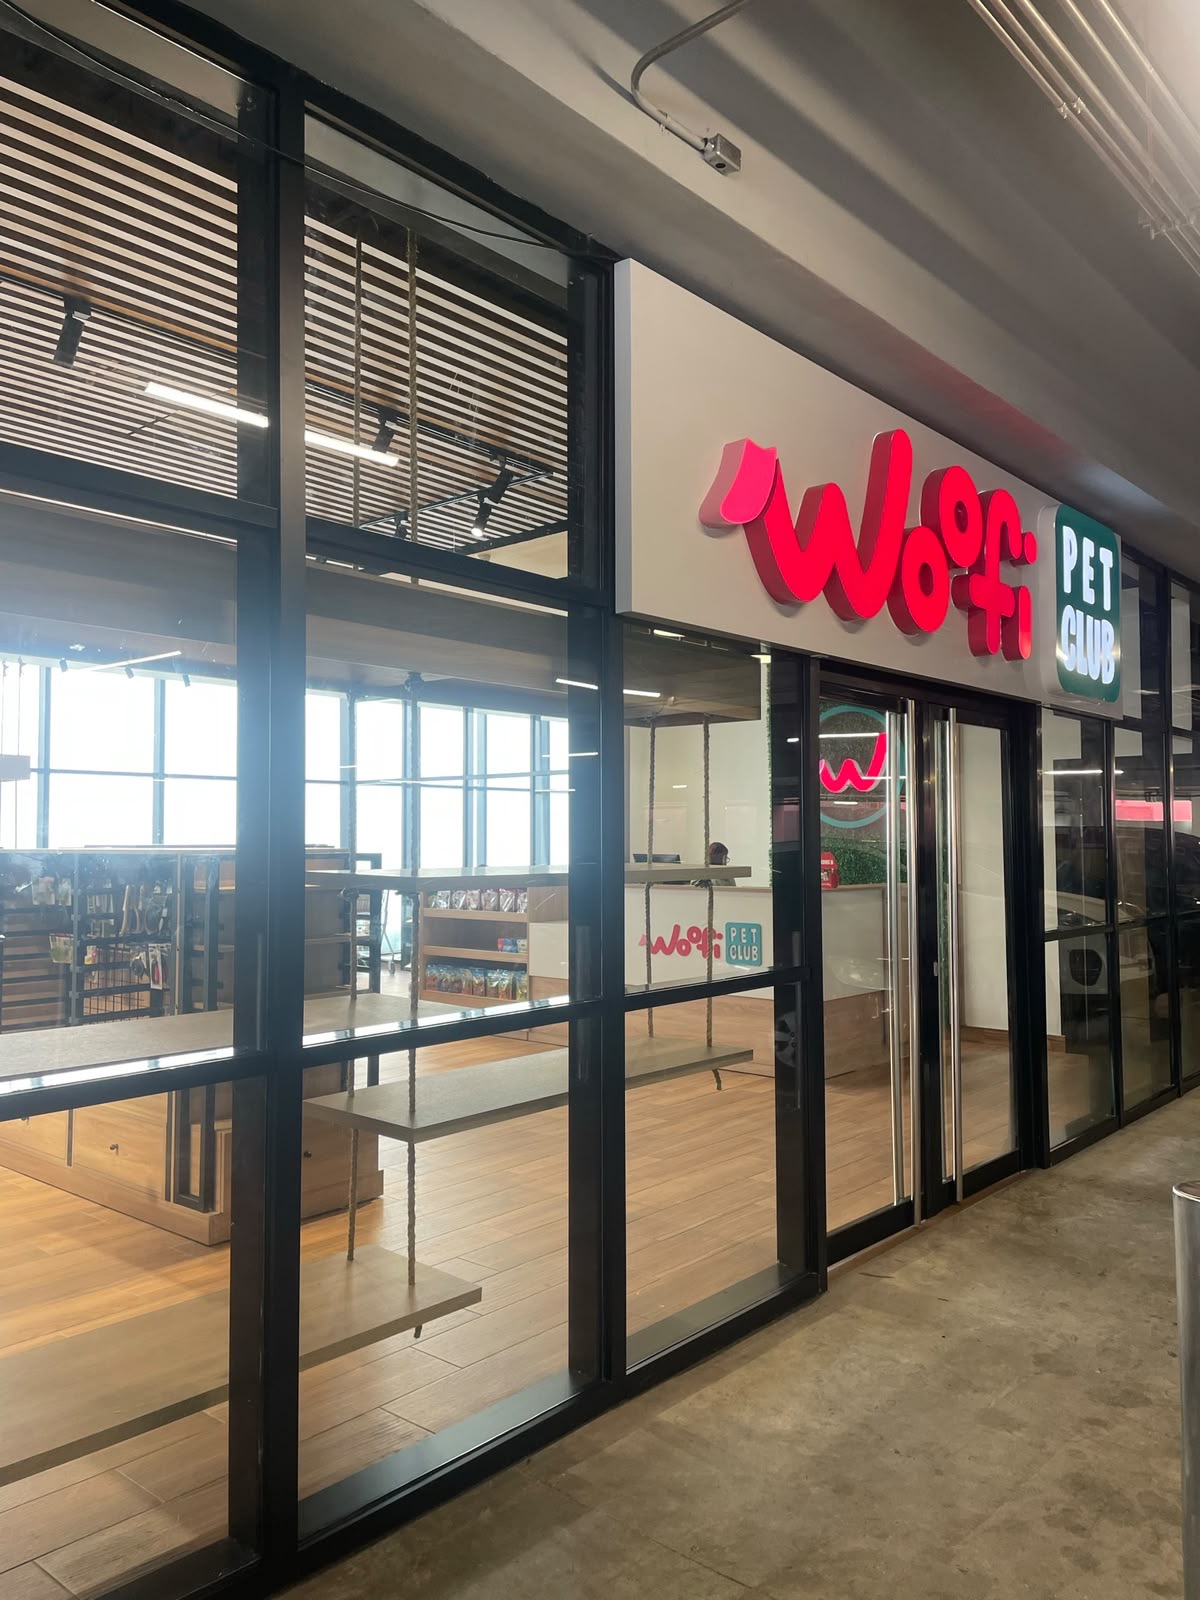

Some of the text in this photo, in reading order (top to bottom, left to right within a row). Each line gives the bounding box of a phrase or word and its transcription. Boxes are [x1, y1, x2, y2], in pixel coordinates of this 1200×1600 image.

[701, 428, 1037, 660] Woofi
[1062, 525, 1113, 611] PET
[1061, 604, 1115, 685] CLUB
[729, 944, 758, 961] CLUB
[730, 927, 756, 943] PET
